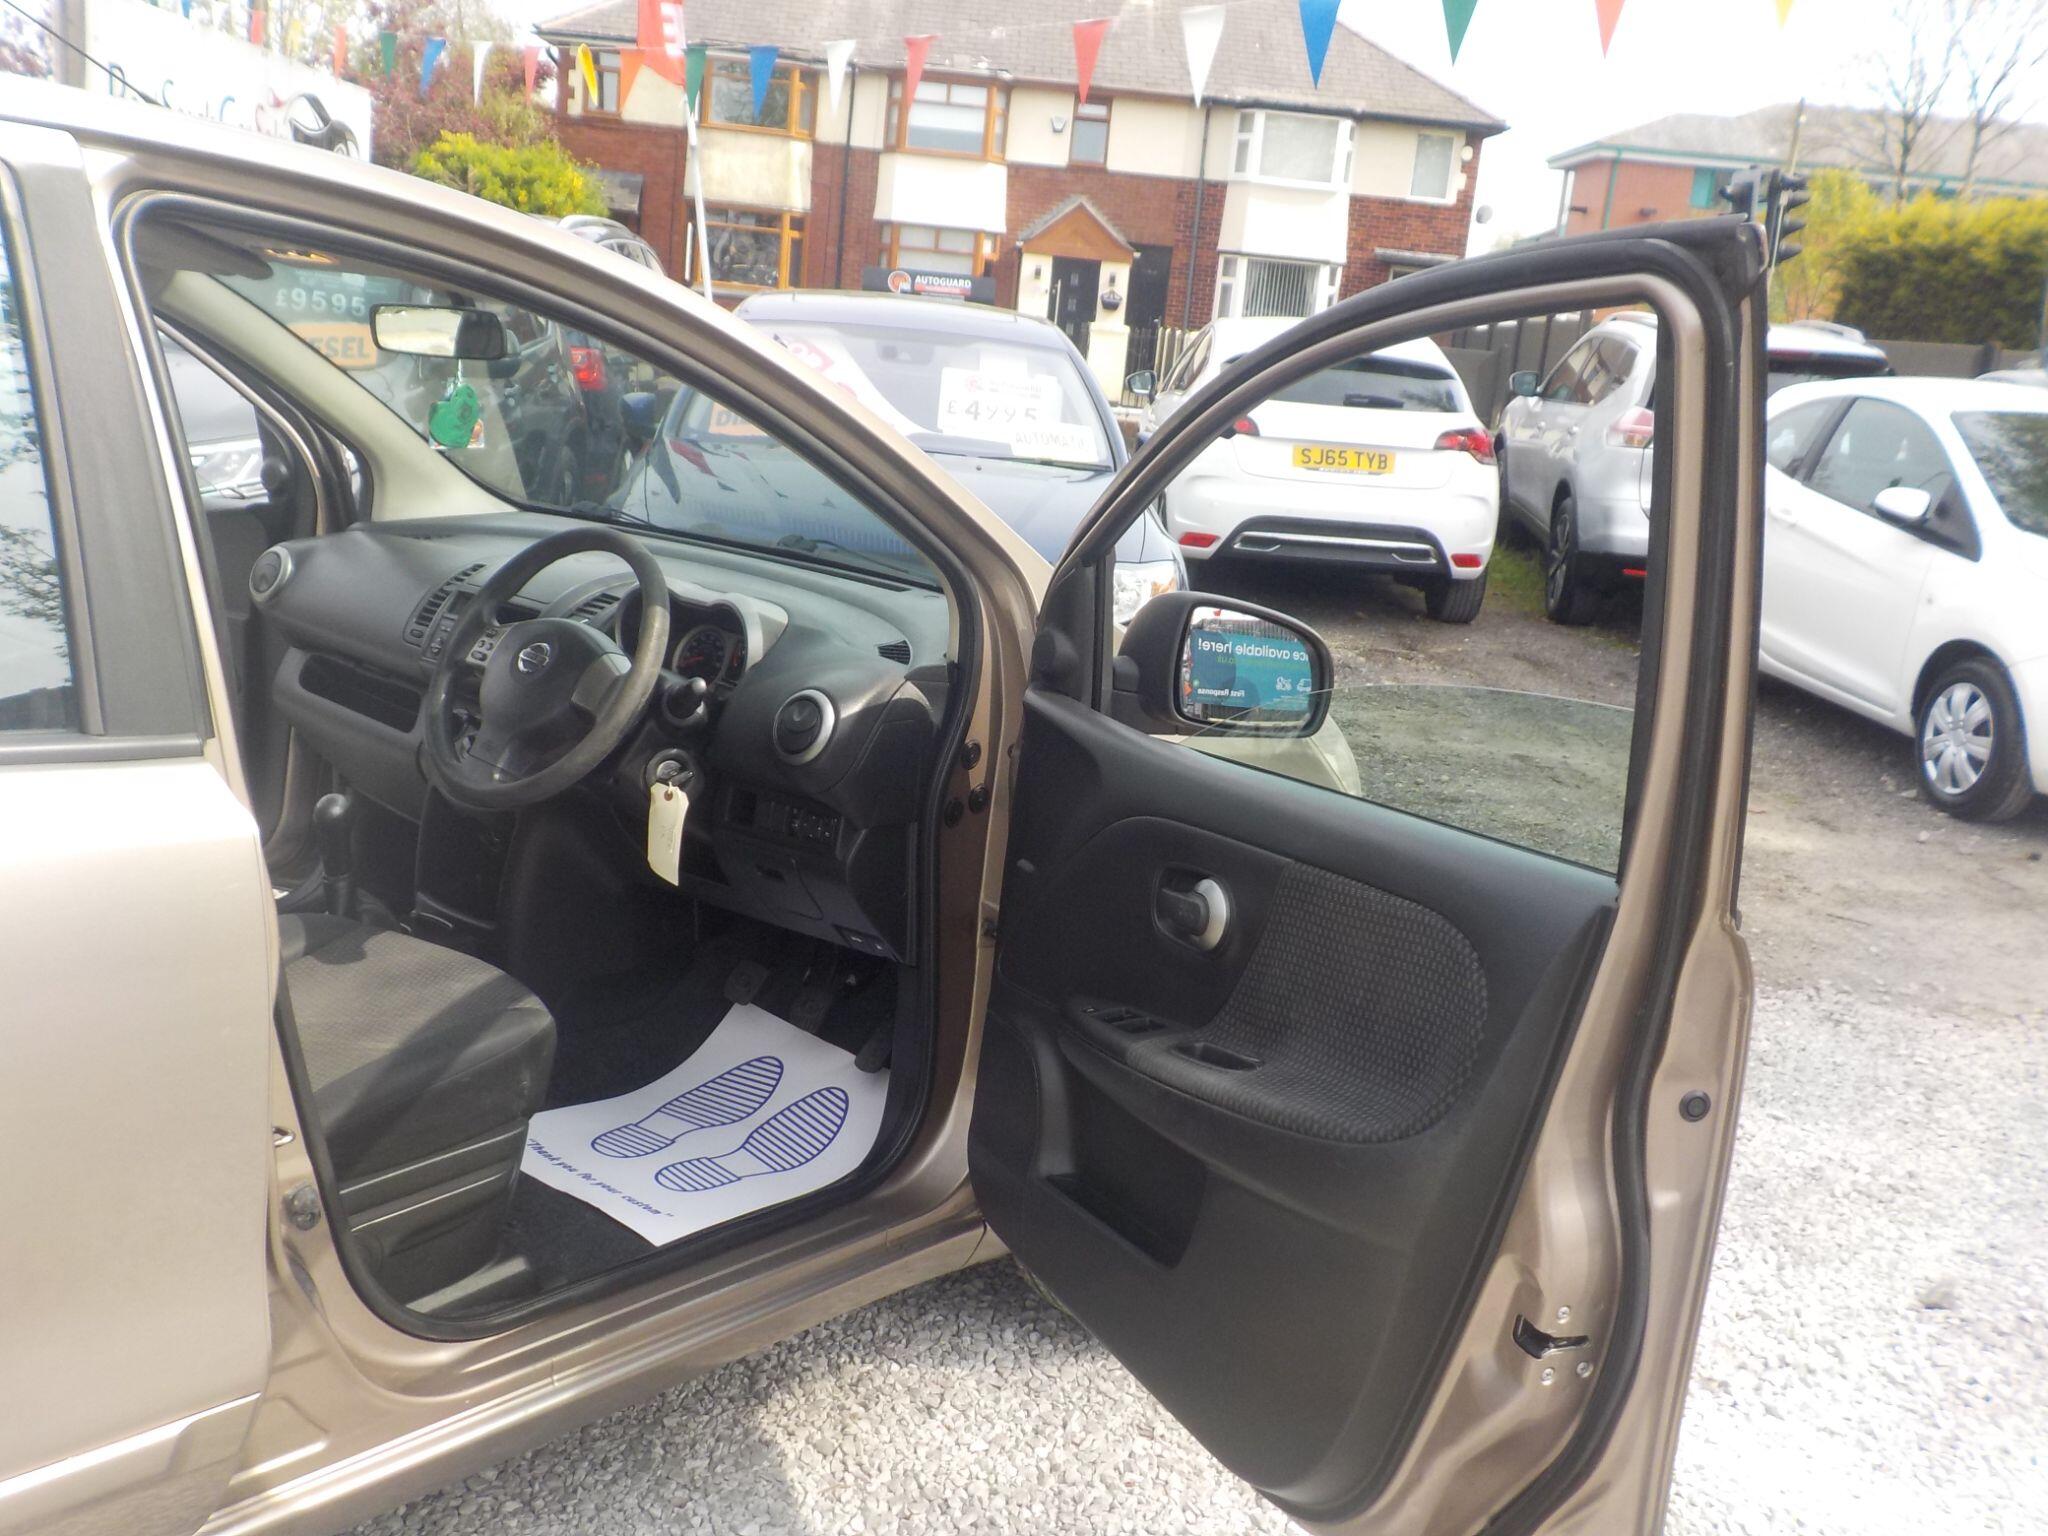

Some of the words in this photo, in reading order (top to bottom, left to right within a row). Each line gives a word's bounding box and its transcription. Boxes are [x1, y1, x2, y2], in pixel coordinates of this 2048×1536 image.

[915, 275, 972, 289] AUTOGUARD
[275, 287, 366, 317] £9595
[1301, 448, 1348, 466] SJ65
[1354, 451, 1388, 470] TYB
[552, 1161, 578, 1173] you
[577, 1171, 597, 1181] for
[591, 1180, 623, 1194] your
